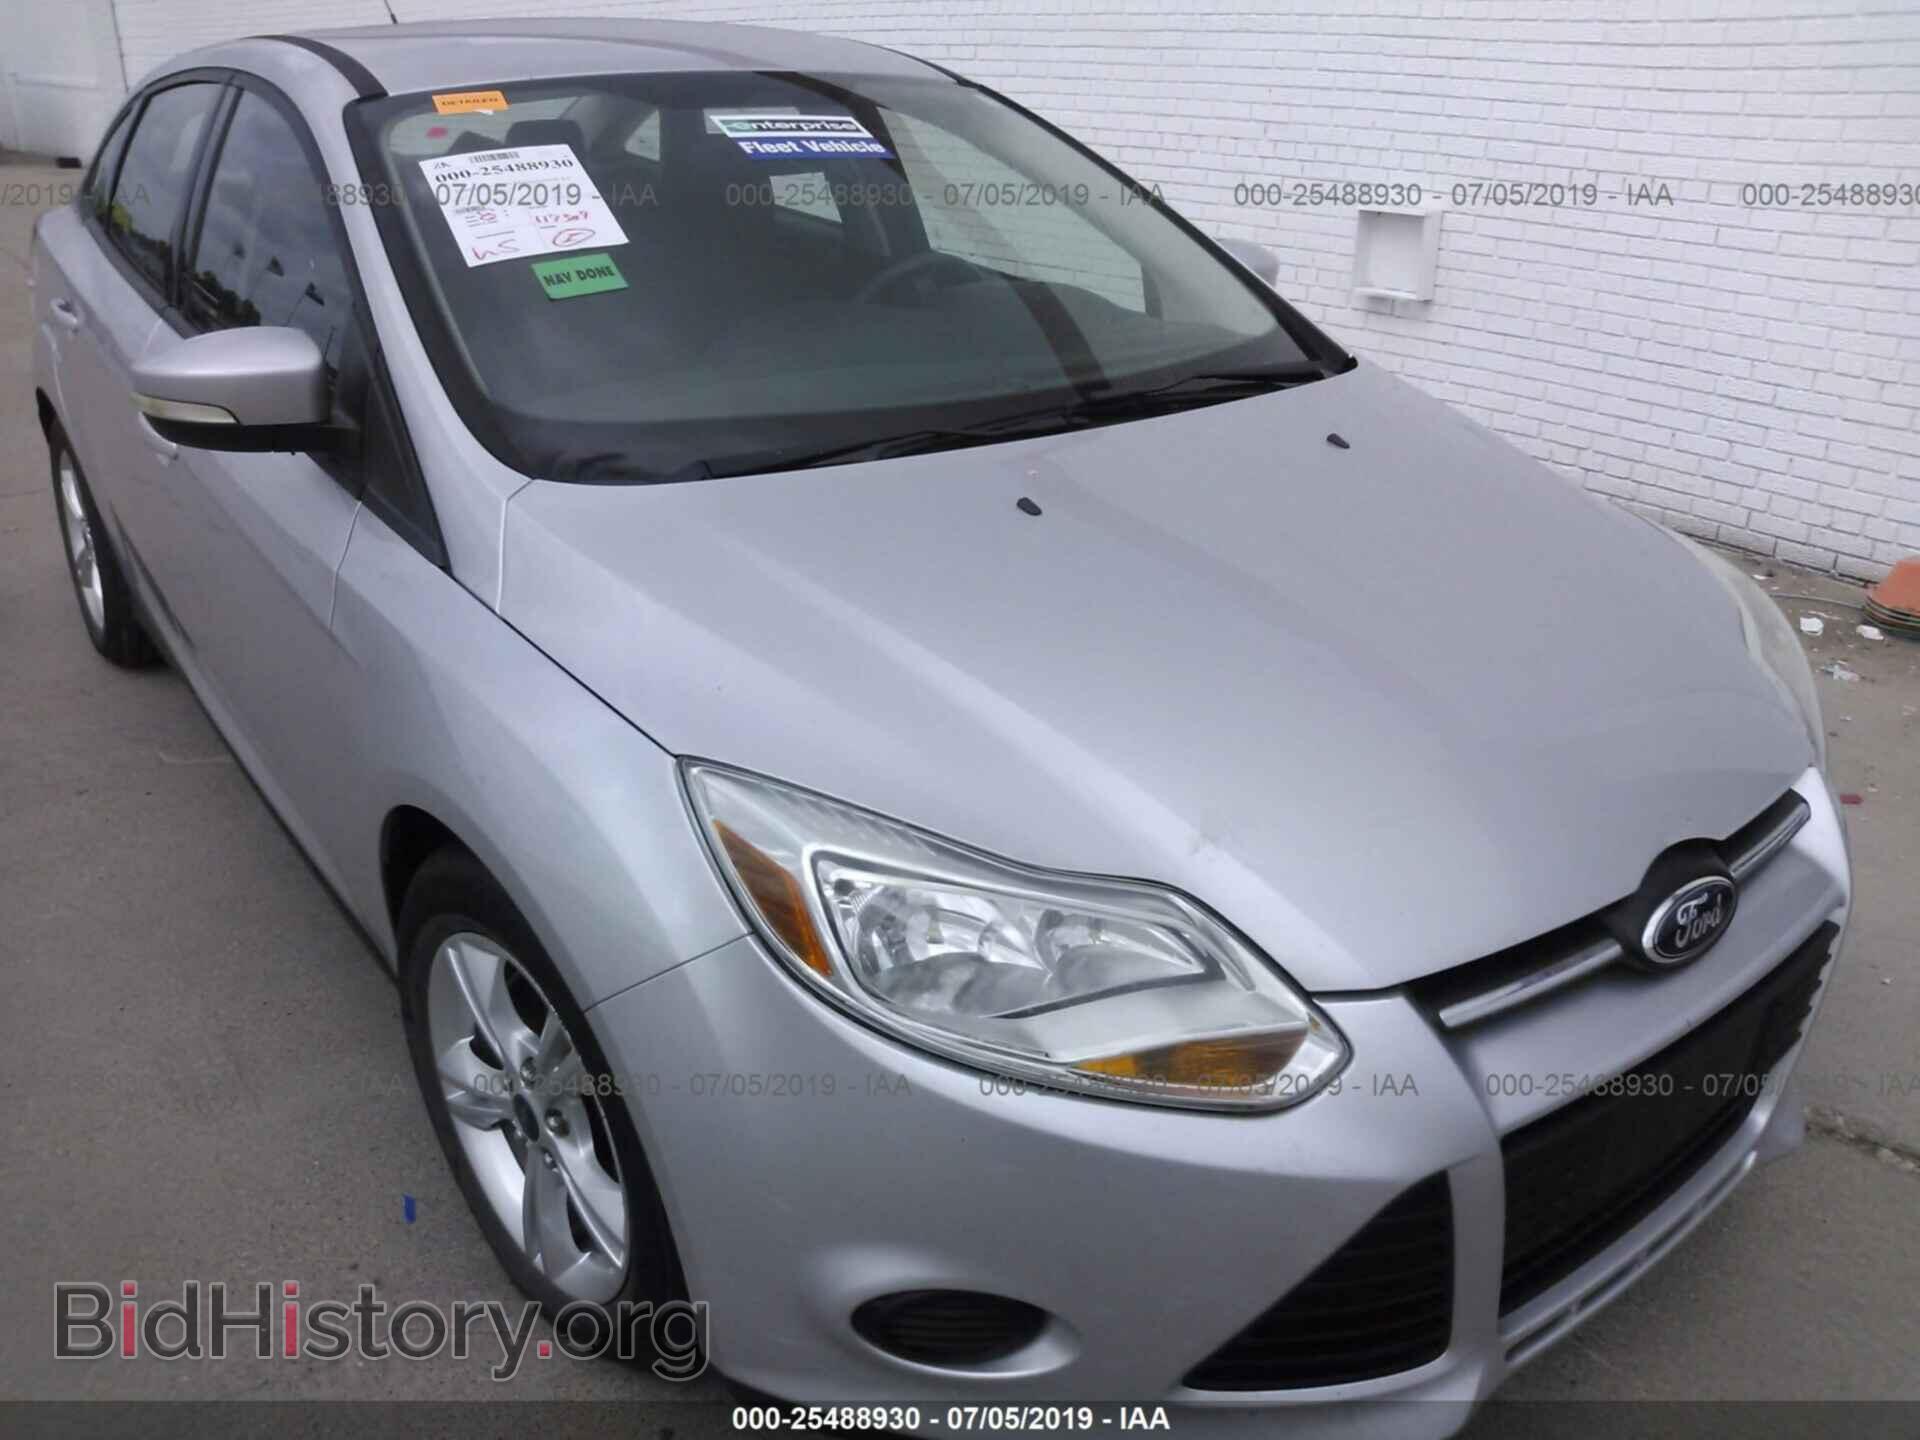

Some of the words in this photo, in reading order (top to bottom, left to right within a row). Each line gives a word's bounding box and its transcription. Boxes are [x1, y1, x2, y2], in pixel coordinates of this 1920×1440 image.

[728, 119, 858, 132] enterprise
[738, 141, 798, 153] Fleet
[803, 140, 887, 153] Vehicle
[435, 159, 574, 182] 000-25488930
[575, 265, 615, 281] DONE
[1676, 892, 1721, 948] Ford
